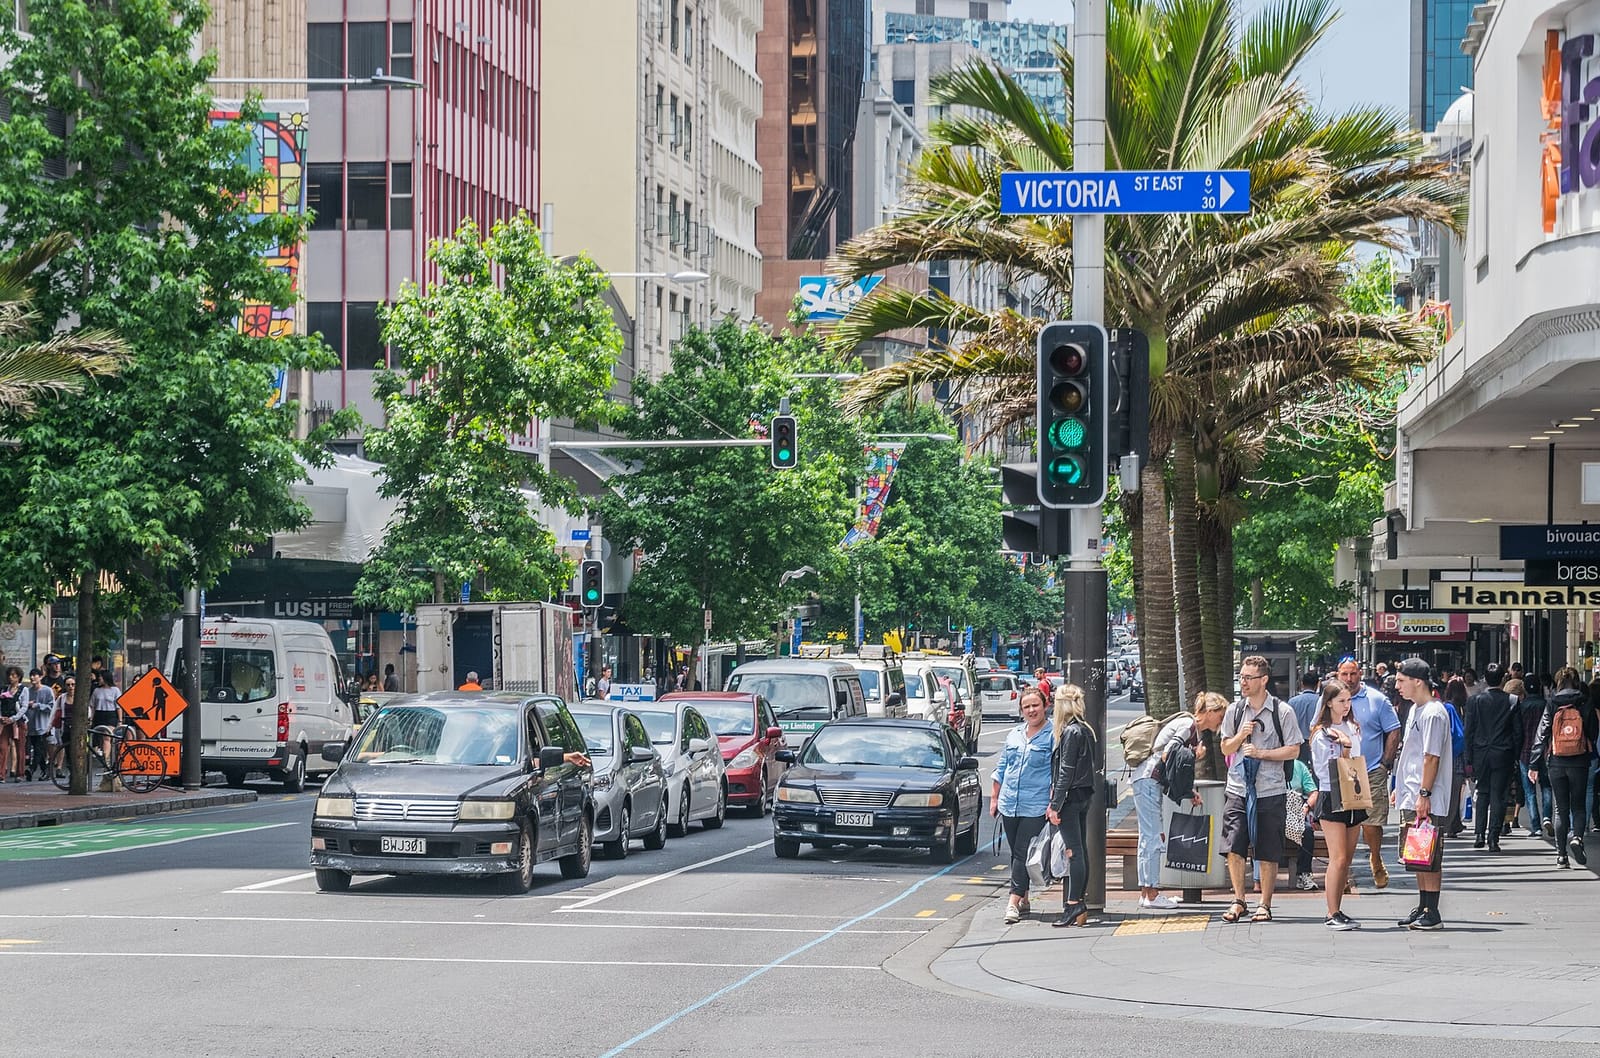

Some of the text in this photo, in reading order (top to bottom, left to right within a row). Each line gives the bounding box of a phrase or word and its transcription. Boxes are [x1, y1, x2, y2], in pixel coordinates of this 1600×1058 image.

[1205, 174, 1213, 187] 6
[1015, 176, 1184, 208] VICTORIA ST EAST
[1201, 196, 1216, 209] 30
[800, 283, 864, 314] SAP
[1546, 529, 1600, 542] bivouac
[1451, 586, 1600, 605] Hannahs
[274, 601, 326, 617] LUSH
[1403, 625, 1445, 633] &VIDEO
[619, 686, 642, 695] TAXI
[790, 722, 815, 730] Limited
[220, 745, 275, 753] directcouriers.co.nz
[836, 813, 871, 825] BUS371
[383, 839, 423, 853] BWJ301
